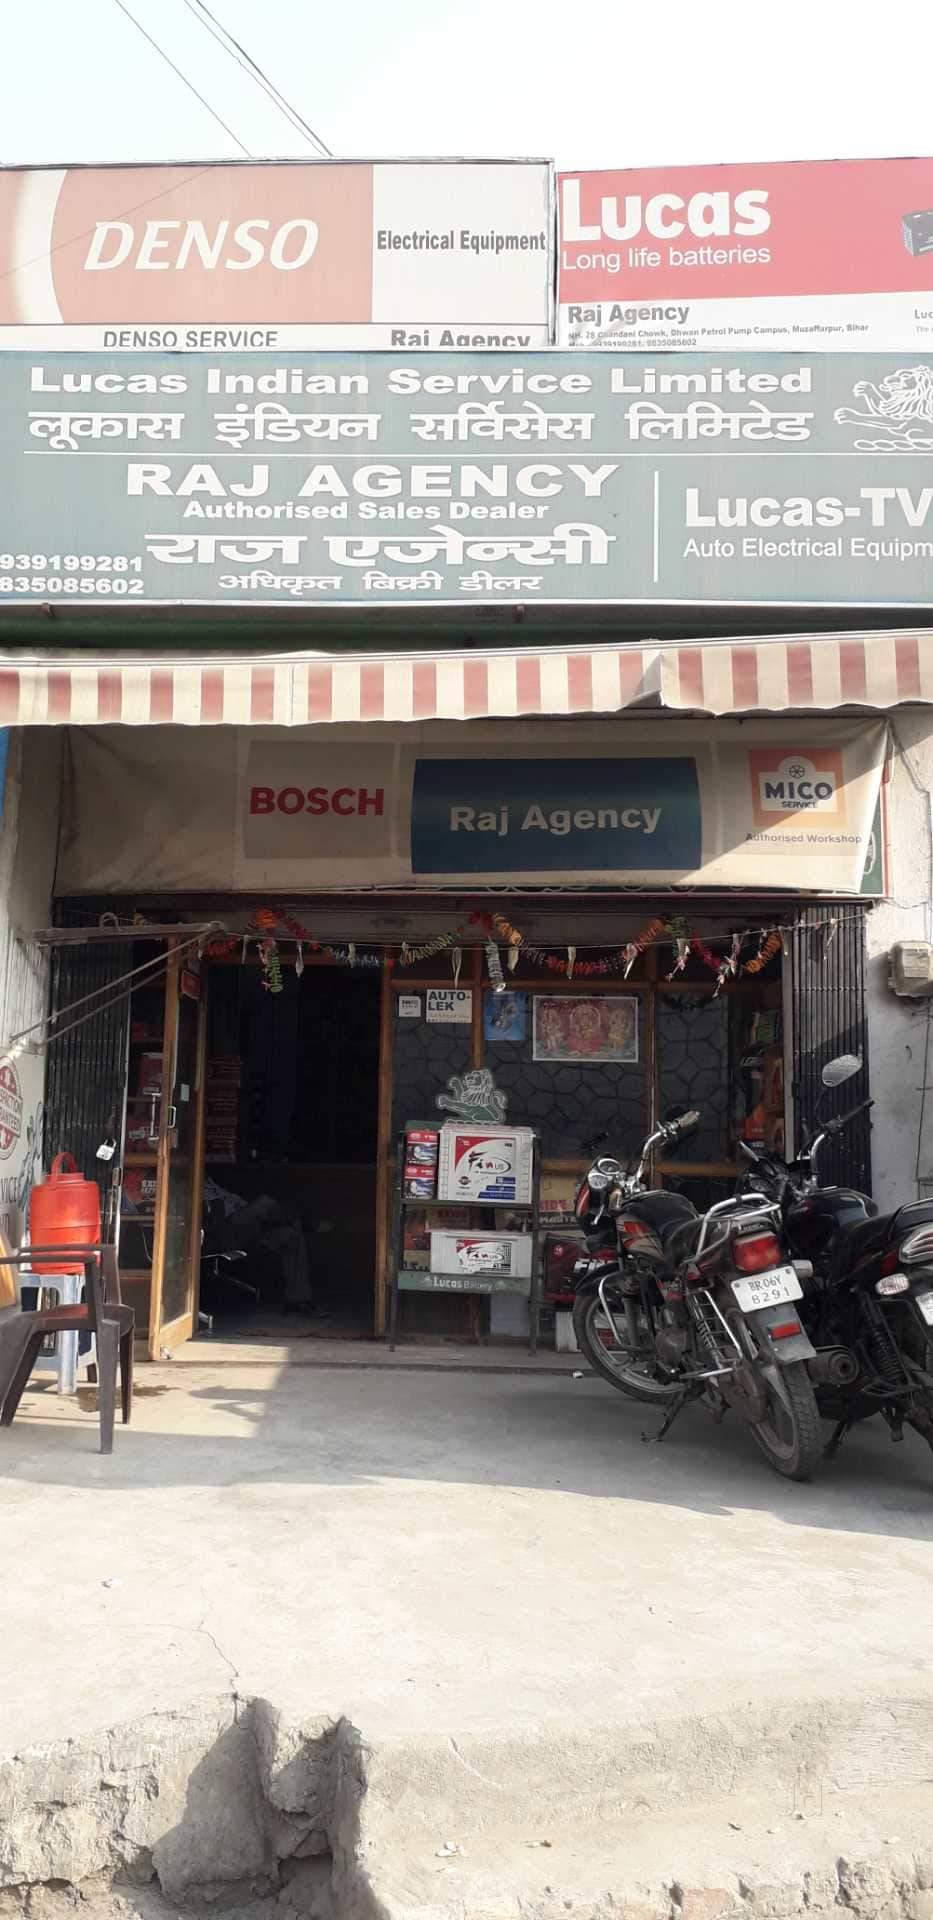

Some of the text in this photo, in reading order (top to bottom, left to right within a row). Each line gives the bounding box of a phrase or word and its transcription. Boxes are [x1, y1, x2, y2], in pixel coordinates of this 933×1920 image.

[562, 178, 771, 241] Lucas
[83, 218, 319, 271] DENSO
[377, 230, 546, 255] Electrical Equipment
[563, 244, 771, 274] Long life batteries
[568, 303, 690, 327] Raj Agency
[103, 330, 278, 347] DENSO SERVICE
[638, 329, 668, 338] Chowk,
[701, 327, 726, 336] Petrol
[728, 326, 752, 337] Pump
[754, 325, 790, 335] Campus,
[792, 323, 844, 334] Muzaffarpur,
[846, 323, 869, 333] Bihar
[30, 366, 812, 395] Lucas Indian Service Limited
[28, 400, 815, 450] लूकास इंडियन सर्विसेस लिमिटेड
[127, 463, 620, 498] RAJ AGENCY
[184, 501, 552, 520] Authorised Sales Dealer
[686, 487, 933, 528] Lucas-TV
[144, 522, 617, 567] राज एजेन्सी
[684, 538, 735, 558] Auto
[743, 537, 842, 558] Electrical
[0, 554, 142, 571] 939199281
[0, 576, 144, 594] 835085602
[218, 569, 544, 596] अधिकृत बिक्री डीलर
[249, 786, 384, 816] BOSCH
[764, 781, 833, 801] MICO
[781, 801, 818, 809] SERVICE
[450, 805, 661, 836] Raj Agency
[746, 833, 863, 845] Authorised Workshop
[428, 991, 471, 1002] AUTO-
[428, 1001, 454, 1012] LEK
[434, 1276, 492, 1292] Lucas Battery
[748, 1275, 782, 1291] BR06Y
[751, 1286, 791, 1305] 8291
